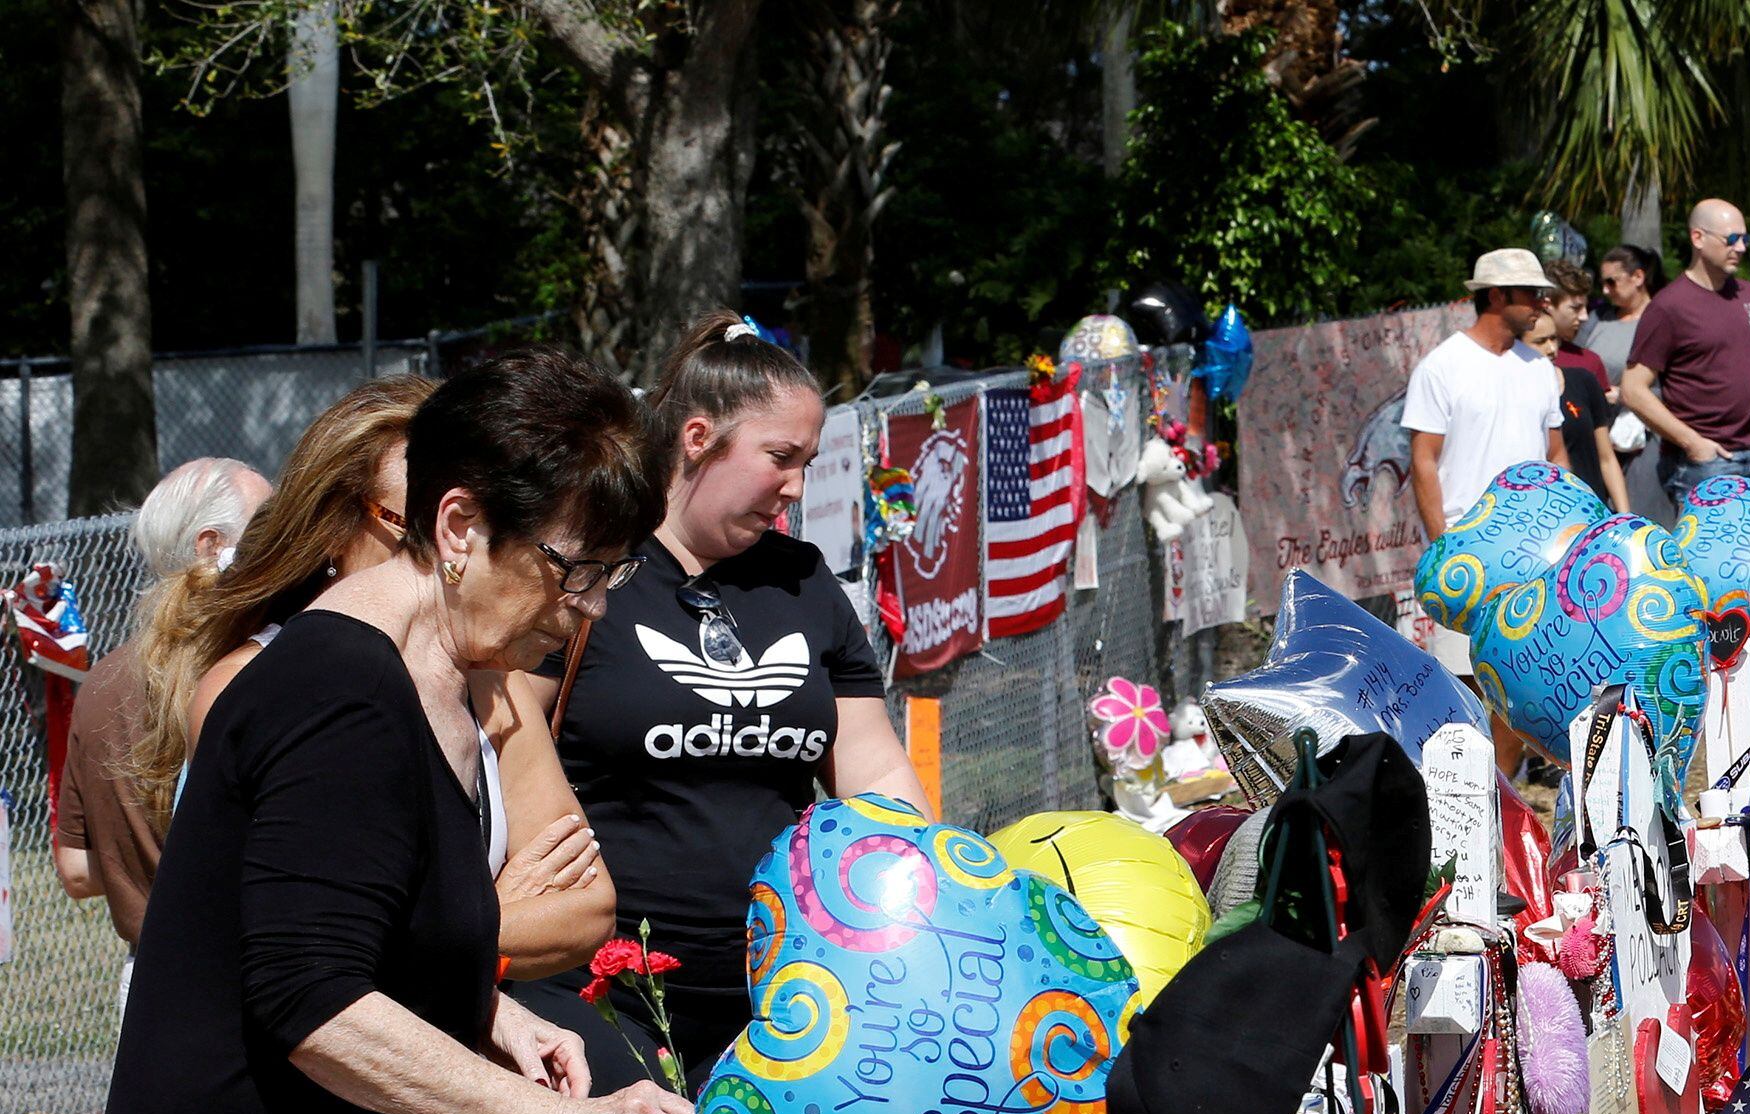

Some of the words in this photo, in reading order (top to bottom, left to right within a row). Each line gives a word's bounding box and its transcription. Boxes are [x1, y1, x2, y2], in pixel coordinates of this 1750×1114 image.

[1470, 489, 1527, 546] You're
[1502, 480, 1581, 578] Special
[1509, 508, 1534, 532] so
[1687, 506, 1725, 564] You're
[1716, 521, 1737, 543] so
[1277, 536, 1311, 569] The
[1316, 528, 1372, 569] Eagles
[1375, 521, 1405, 552] will
[1501, 613, 1571, 682] You're
[1537, 651, 1565, 685] so
[1523, 625, 1632, 752] Special
[644, 713, 828, 762] adidas
[1585, 713, 1611, 773] Tri-State
[1429, 767, 1459, 784] HOPE
[1468, 814, 1482, 828] you
[1676, 899, 1689, 924] CRT
[833, 957, 907, 1111] You're
[899, 997, 945, 1063] so
